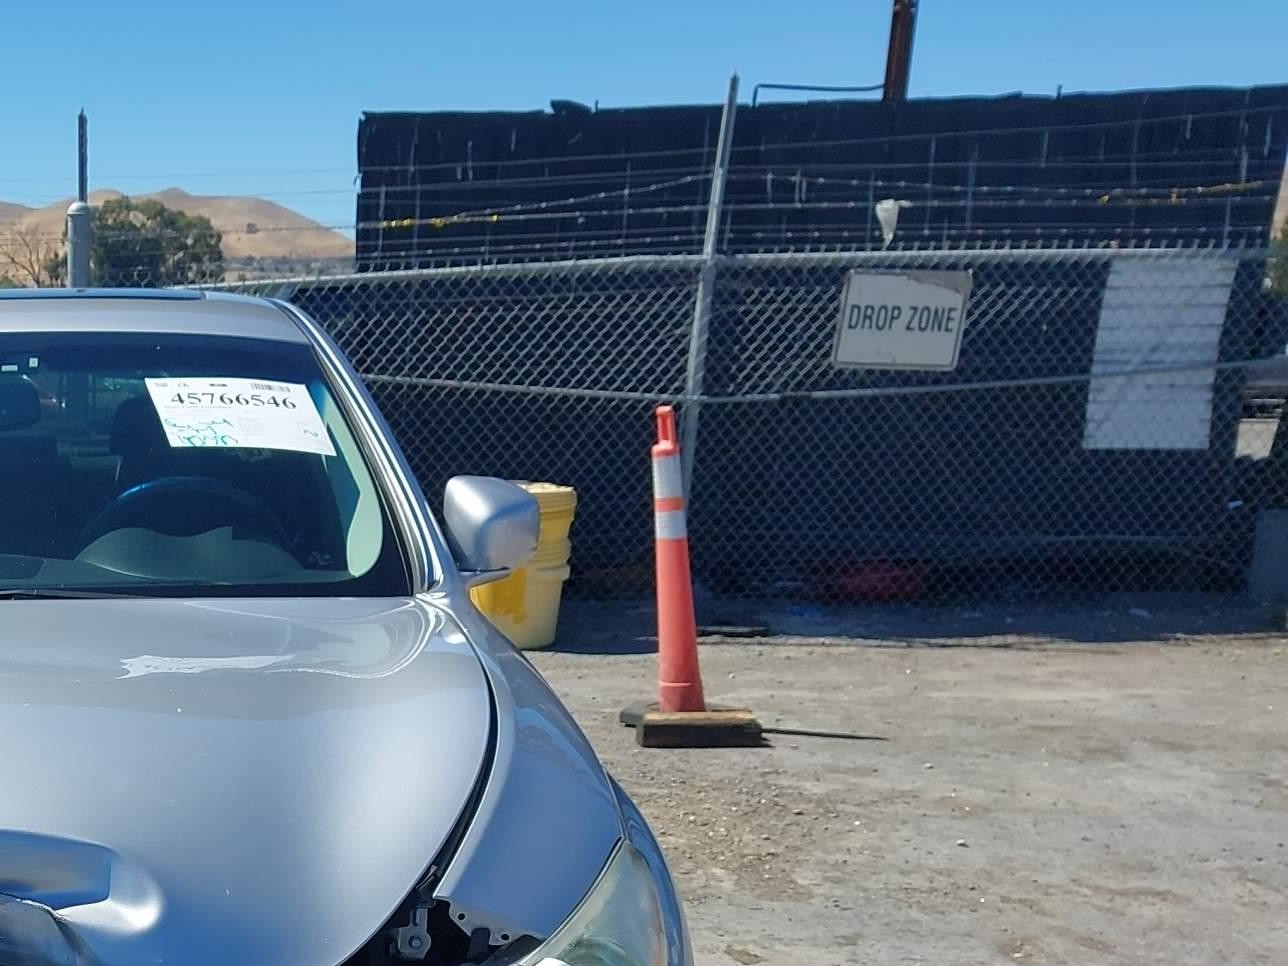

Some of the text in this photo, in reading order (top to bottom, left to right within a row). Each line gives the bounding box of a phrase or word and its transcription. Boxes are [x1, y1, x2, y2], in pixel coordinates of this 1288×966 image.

[848, 304, 957, 333] DROP ZONE
[171, 392, 297, 410] 45766546
